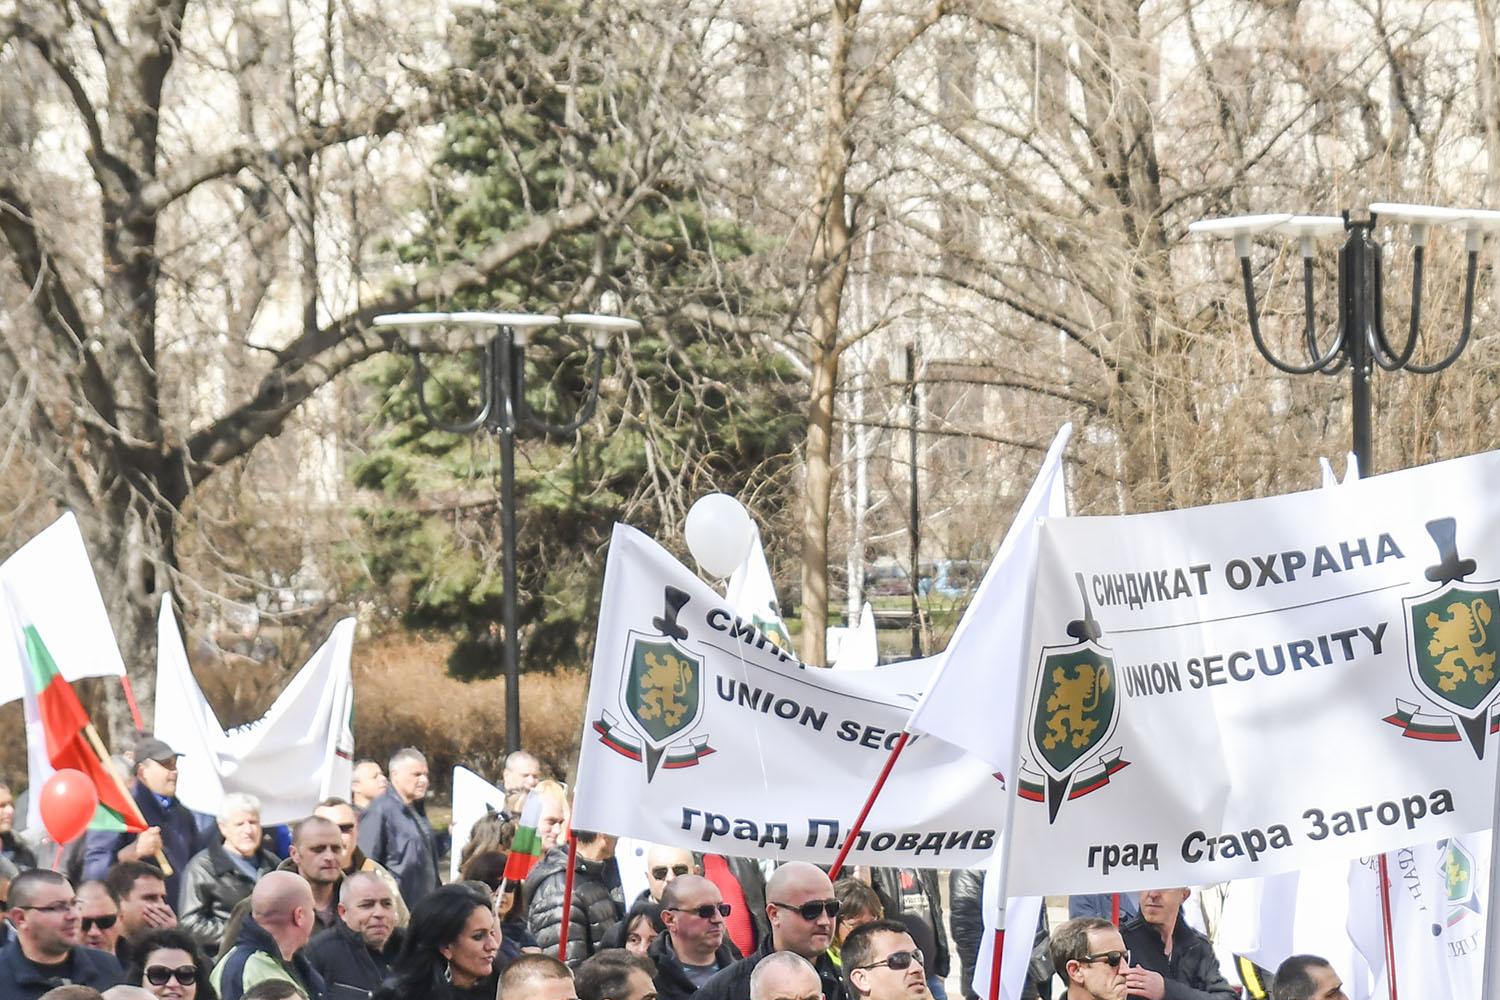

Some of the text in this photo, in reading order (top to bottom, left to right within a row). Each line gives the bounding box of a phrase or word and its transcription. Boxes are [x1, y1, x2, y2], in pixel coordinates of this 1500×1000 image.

[1092, 531, 1406, 611] СИНДИКАТ ОХРАНА
[1122, 622, 1389, 698] UNION SECURITY
[716, 674, 829, 731] UNION
[680, 806, 790, 850] град
[1087, 786, 1456, 875] град Стара Загора
